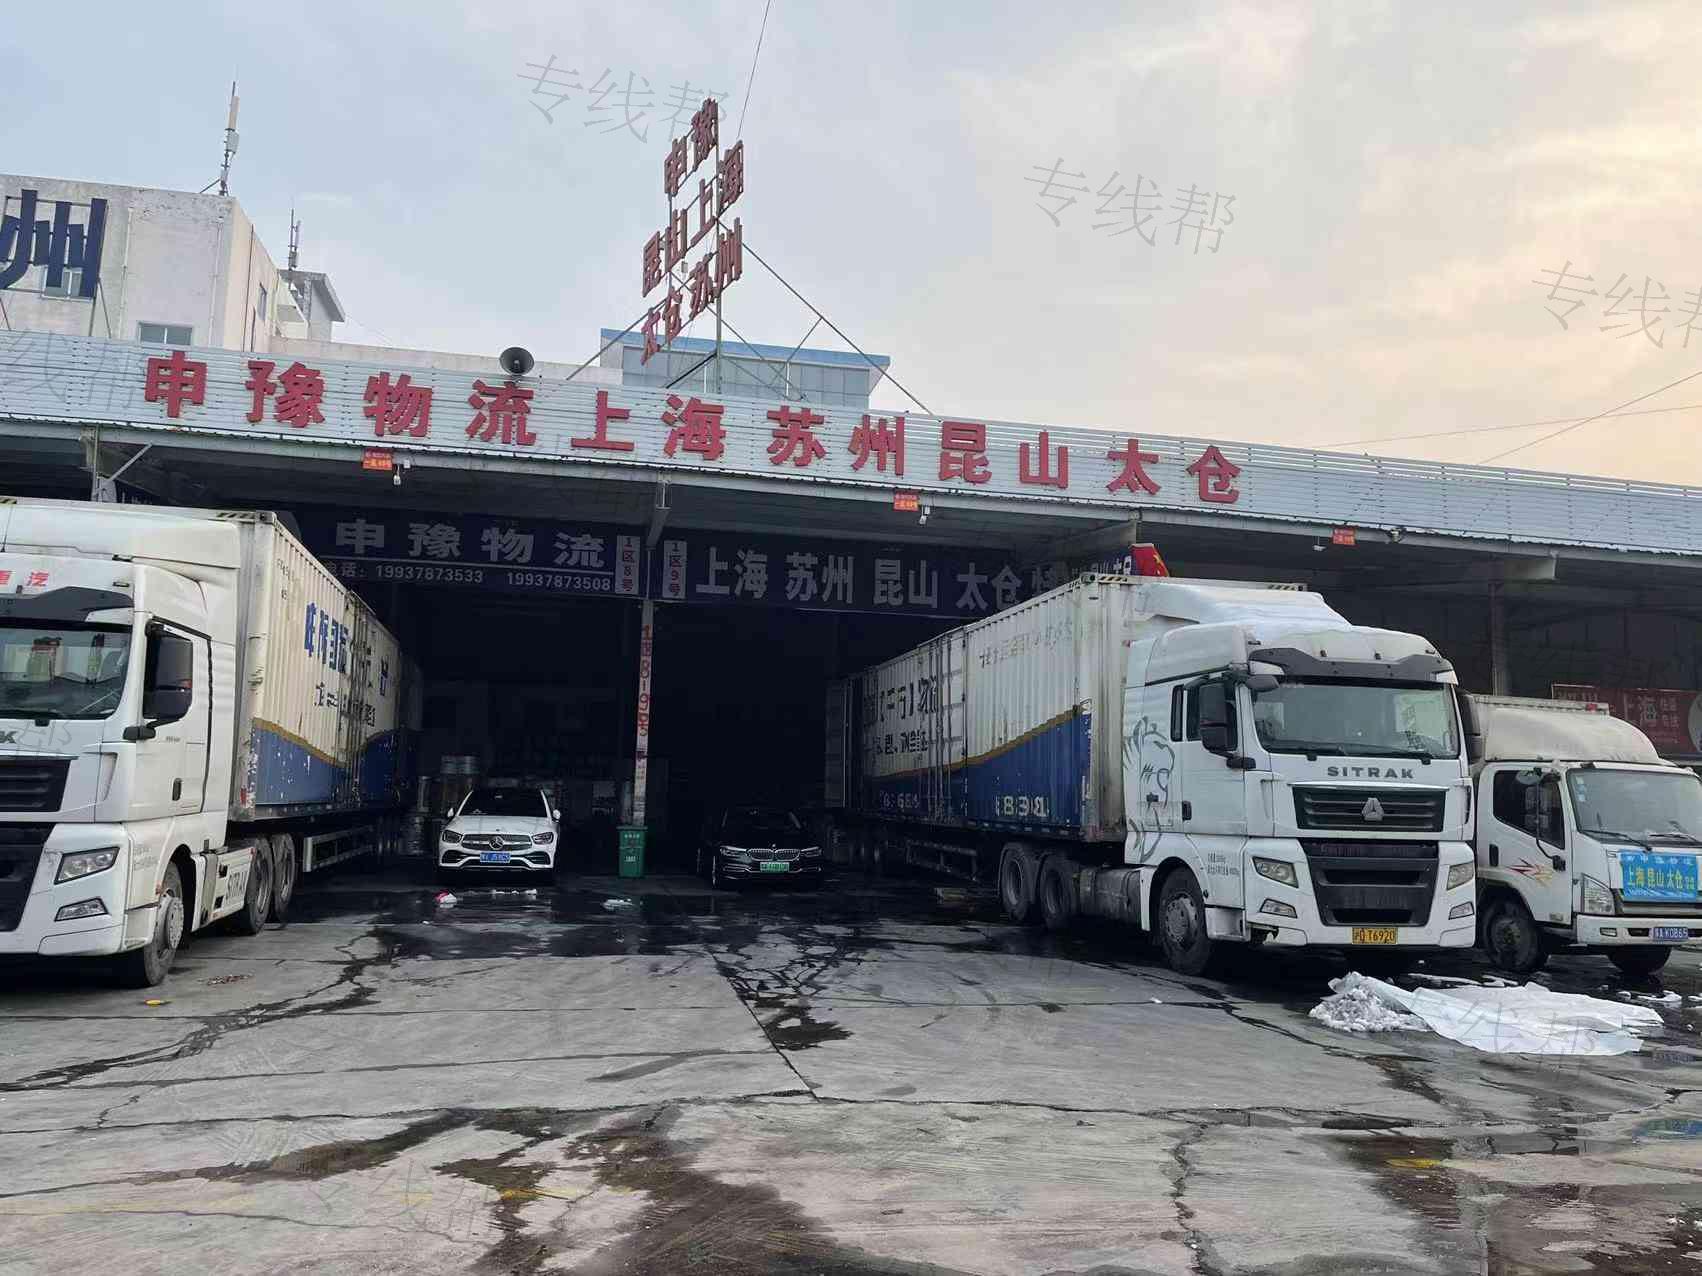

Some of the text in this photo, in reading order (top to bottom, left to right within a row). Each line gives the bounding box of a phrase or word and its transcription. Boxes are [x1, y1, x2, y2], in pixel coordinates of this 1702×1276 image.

[335, 518, 605, 568] 申豫物流
[375, 564, 483, 584] 19937873533
[507, 571, 611, 592] 19937873508
[1327, 766, 1414, 779] SITRAK
